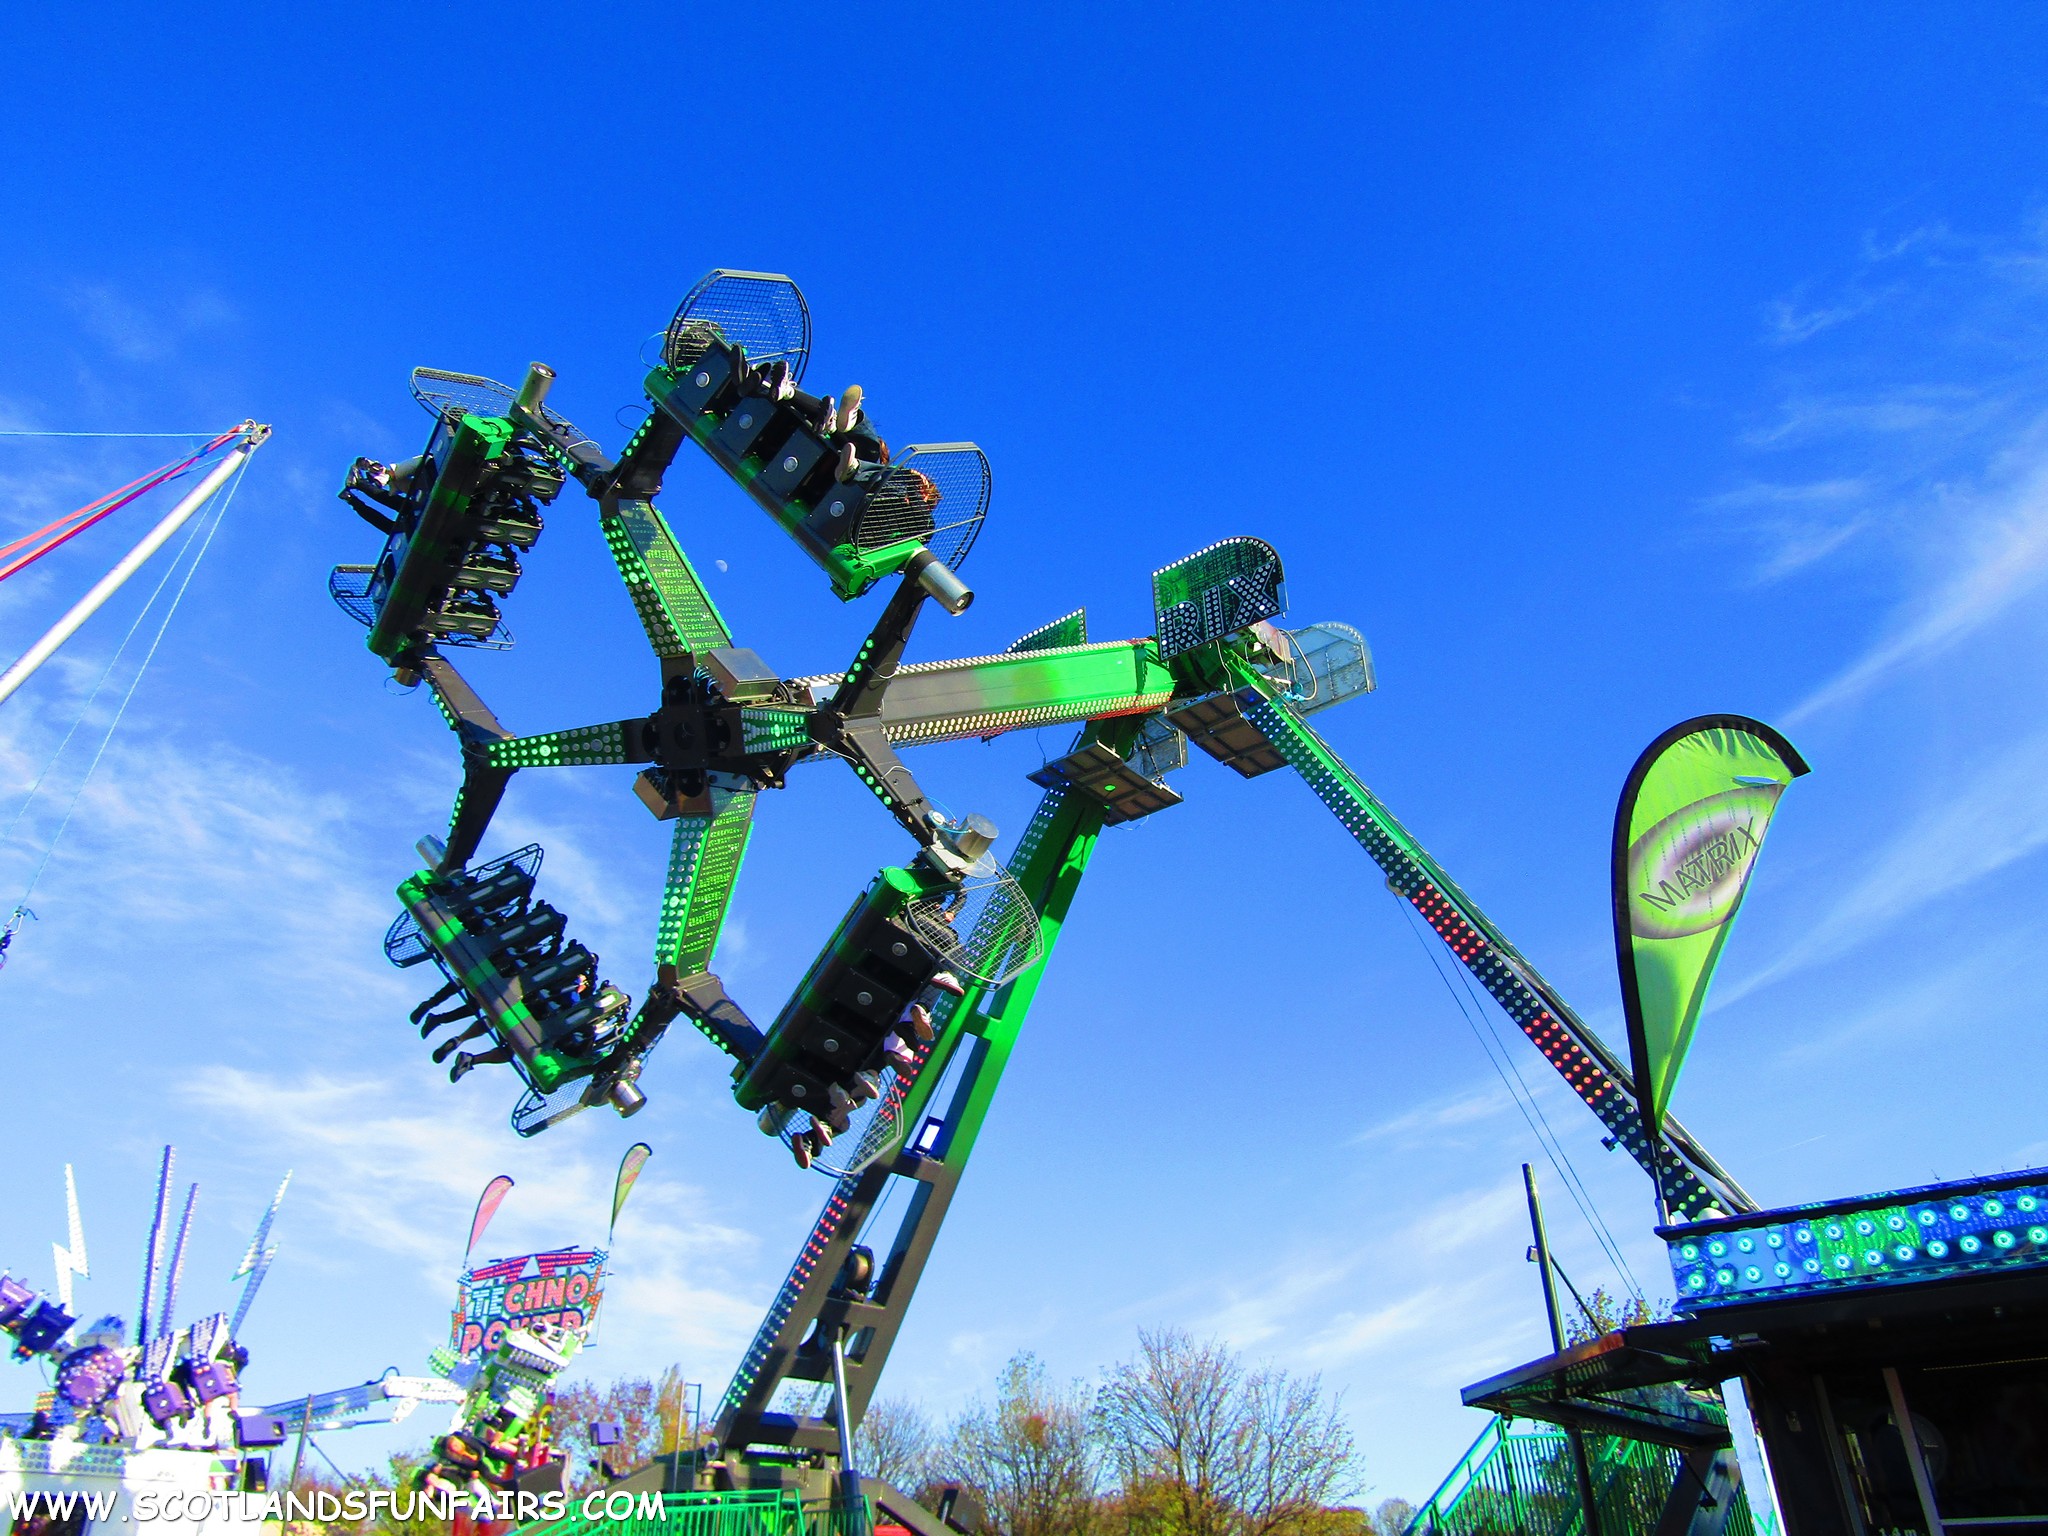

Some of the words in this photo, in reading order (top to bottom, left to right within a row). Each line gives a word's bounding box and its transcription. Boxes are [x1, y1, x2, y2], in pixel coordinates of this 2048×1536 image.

[1158, 561, 1280, 660] RIX
[1638, 816, 1758, 912] MATRIX
[472, 1273, 590, 1318] TECHNO
